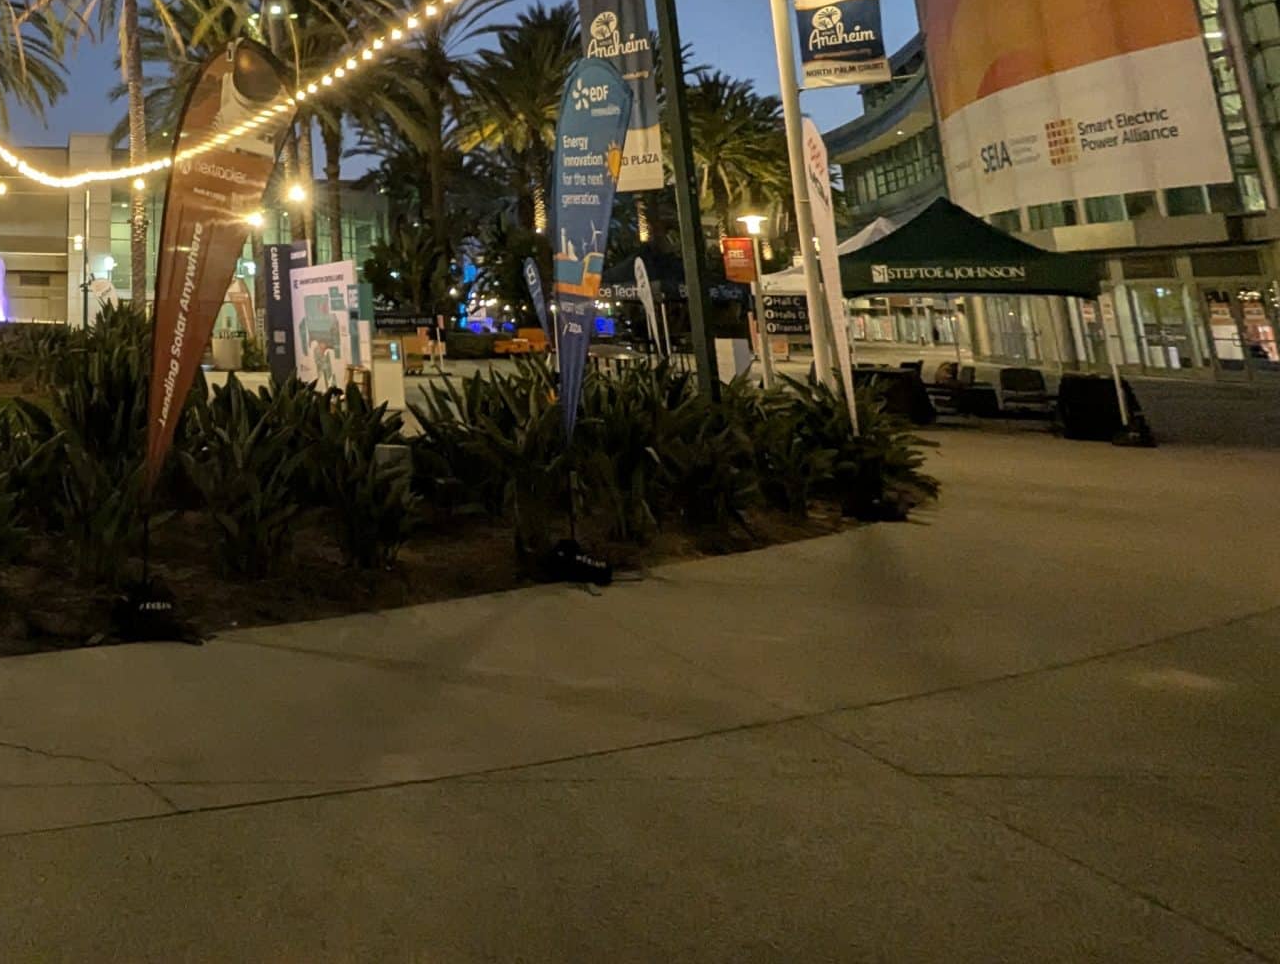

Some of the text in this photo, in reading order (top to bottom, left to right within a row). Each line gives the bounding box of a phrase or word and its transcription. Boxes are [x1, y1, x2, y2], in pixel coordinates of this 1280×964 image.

[587, 30, 650, 59] Anaheim
[808, 21, 876, 52] Anaheim
[806, 67, 832, 77] NORTH
[1077, 108, 1169, 136] Smart Electric
[563, 135, 588, 151] Energy
[1080, 125, 1179, 152] Power Alliance
[631, 152, 660, 166] PLAZA
[980, 139, 1013, 173] SEIA
[562, 172, 573, 185] for
[574, 172, 586, 185] the
[270, 247, 280, 281] CAMPUS
[171, 312, 187, 357] Solar
[180, 222, 203, 312] Anywhere
